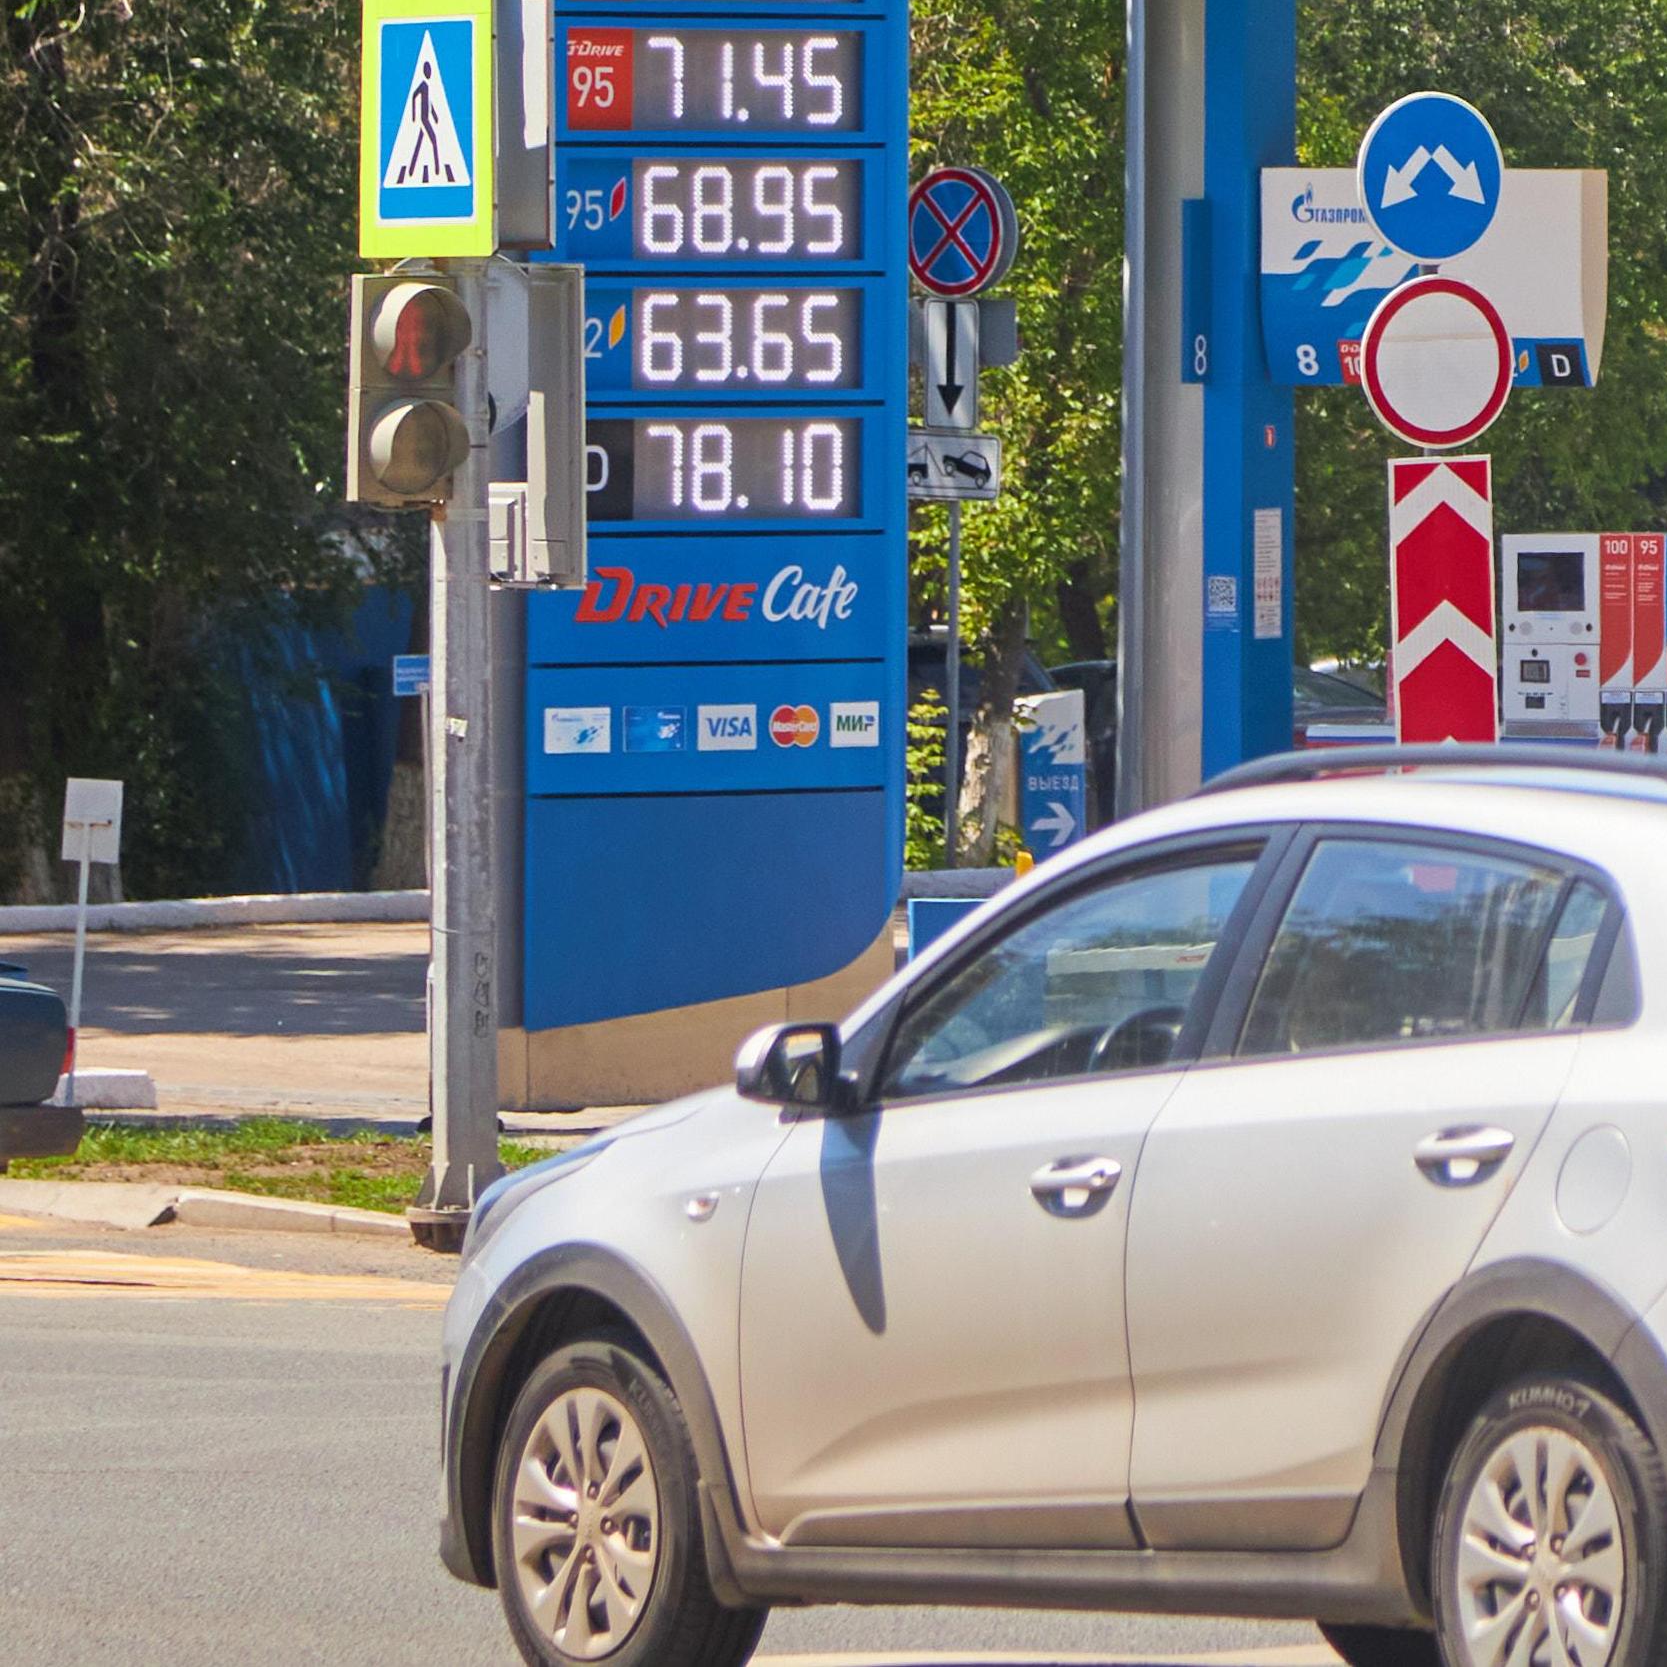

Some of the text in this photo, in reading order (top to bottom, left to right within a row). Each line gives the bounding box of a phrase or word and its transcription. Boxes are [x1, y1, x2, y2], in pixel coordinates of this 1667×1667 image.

[572, 66, 614, 108] 95
[647, 36, 843, 124] 71.45
[643, 166, 843, 254] 68.95
[585, 318, 603, 358] 2
[642, 294, 842, 382] 63.65
[1194, 334, 1207, 376] 8
[1296, 344, 1320, 376] 8
[1551, 354, 1571, 377] D
[647, 423, 843, 511] 78.10
[1604, 540, 1628, 555] 100
[1640, 540, 1658, 555] 95
[574, 564, 859, 630] DRIVE Cafe
[706, 716, 753, 737] VISA
[836, 715, 876, 732] МИР
[1027, 775, 1079, 792] ВЫЕЗД
